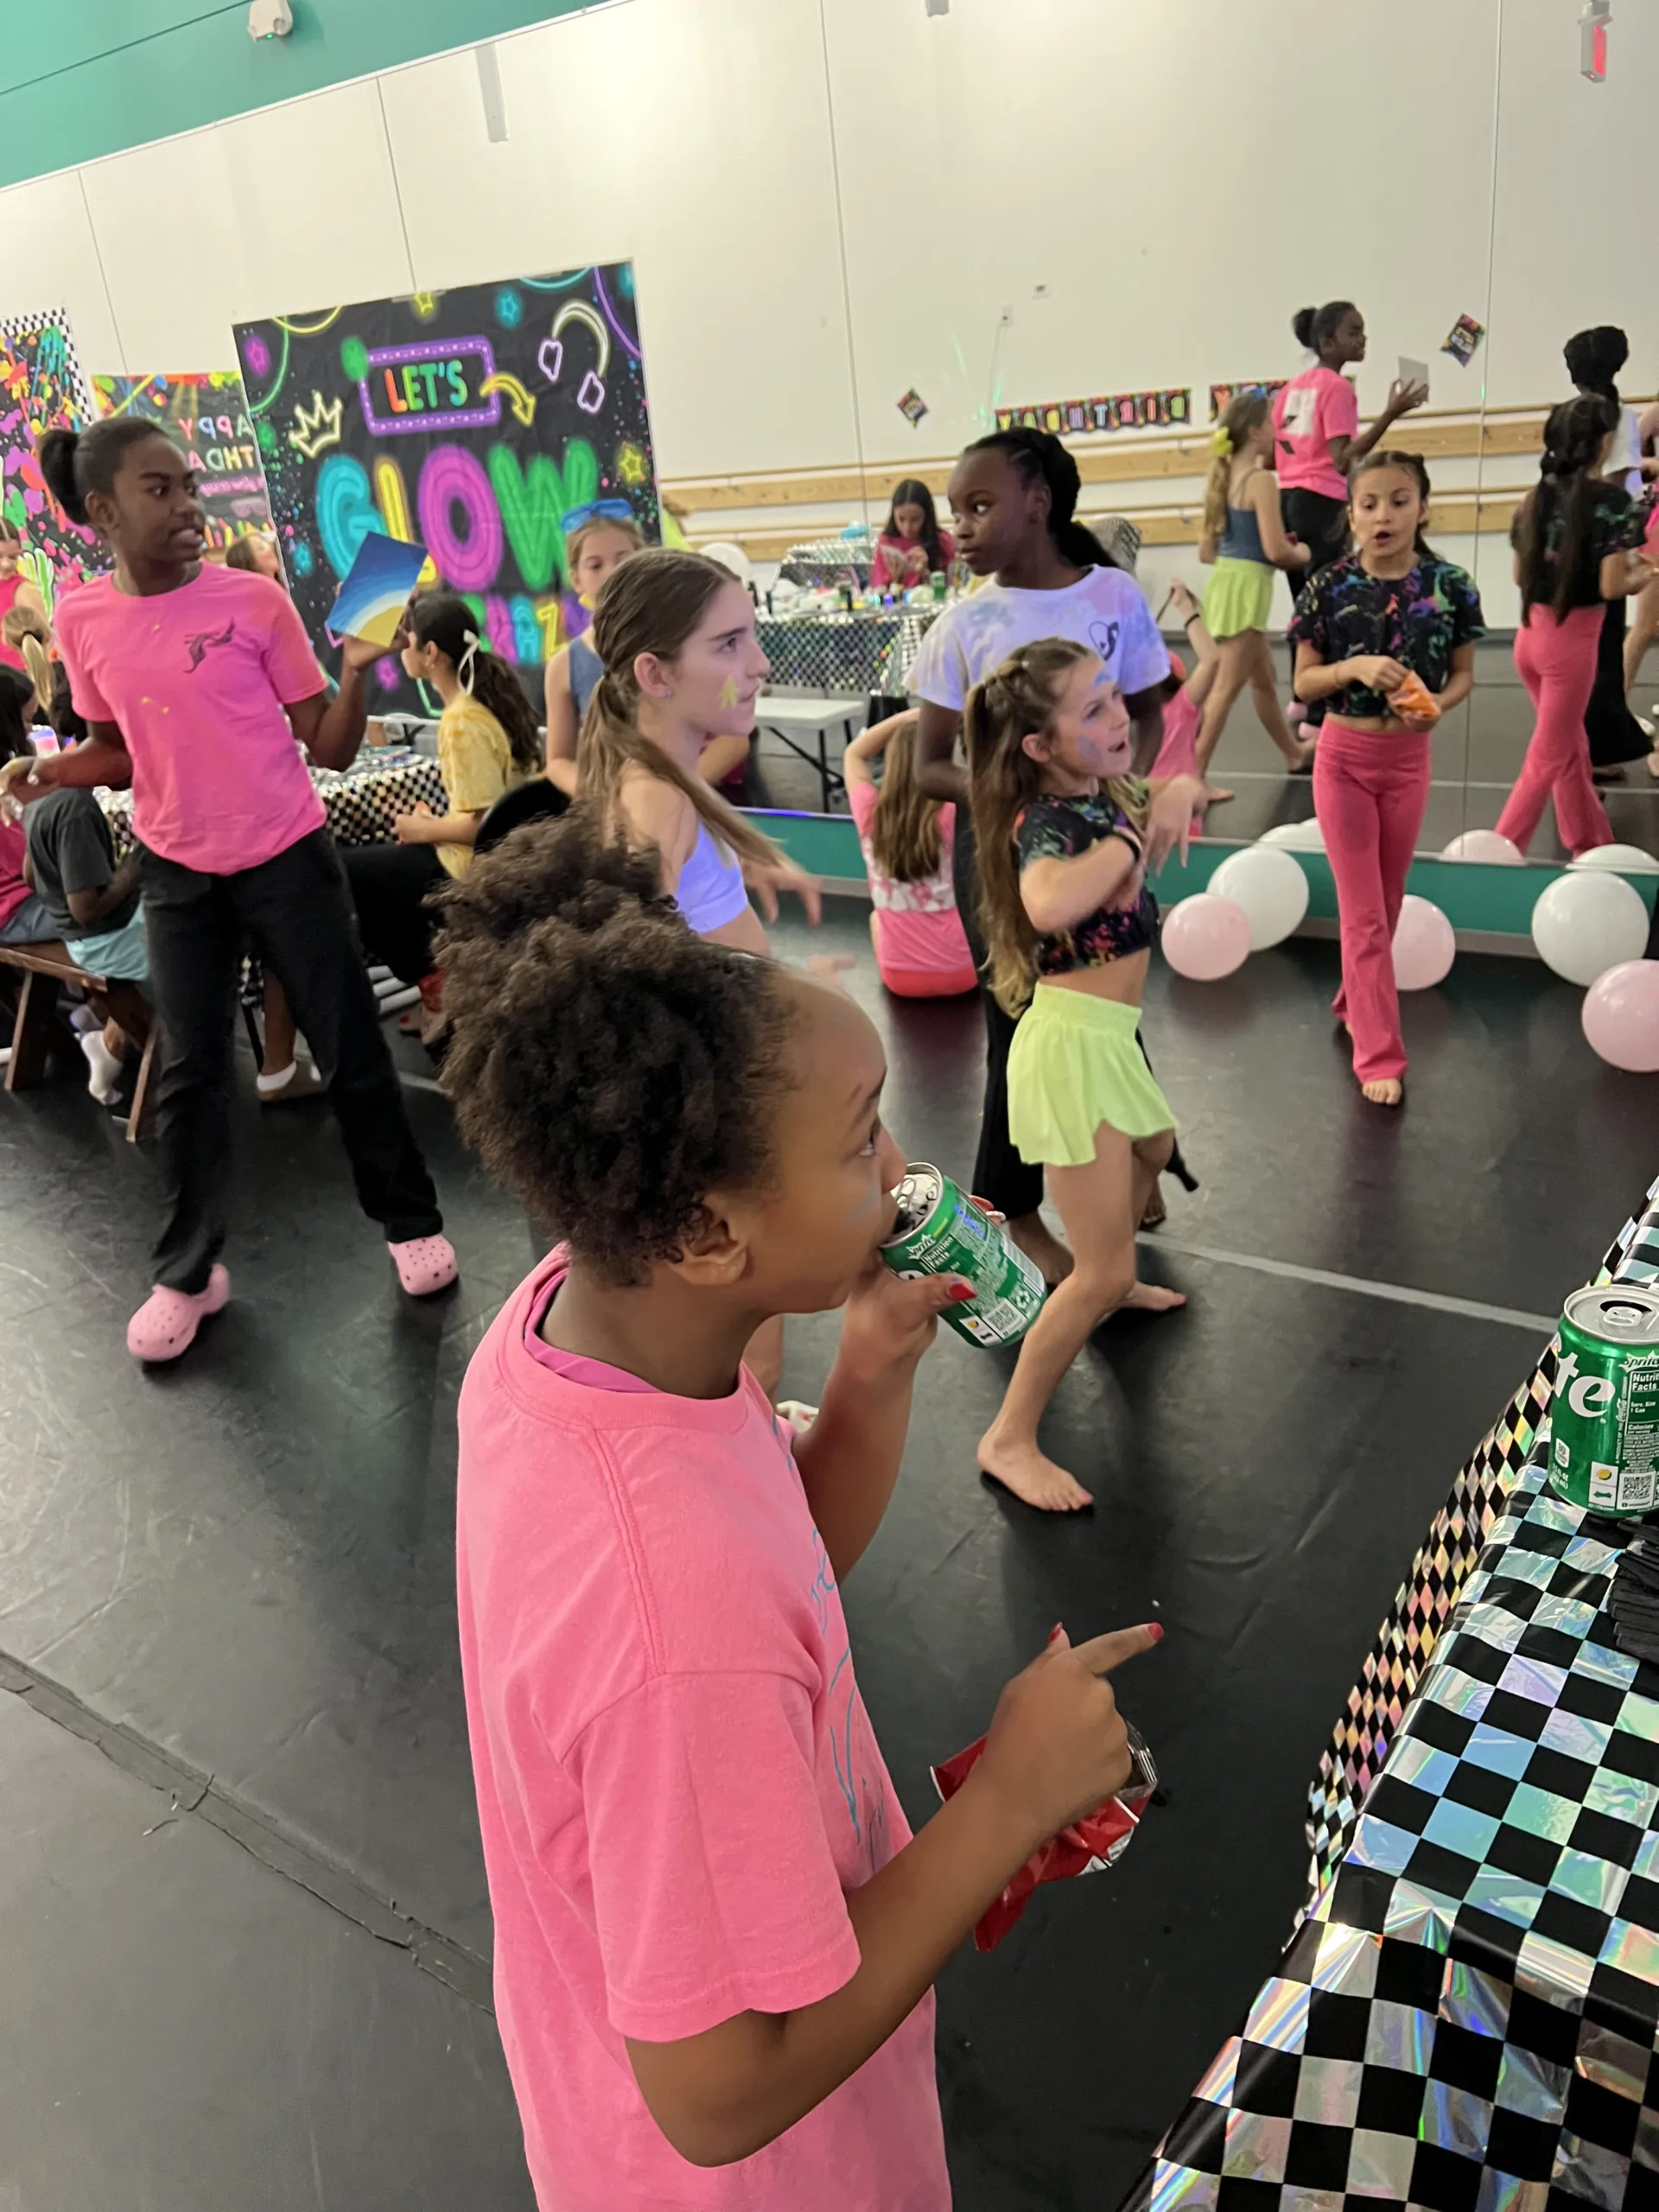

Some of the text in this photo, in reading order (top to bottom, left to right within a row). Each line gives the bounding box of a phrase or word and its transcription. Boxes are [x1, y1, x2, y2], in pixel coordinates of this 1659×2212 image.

[385, 359, 467, 413] LET'S
[315, 436, 600, 593] GLOW
[1555, 1344, 1616, 1418] te
[1632, 1372, 1659, 1382] Nutrit
[1632, 1382, 1657, 1391] Facts
